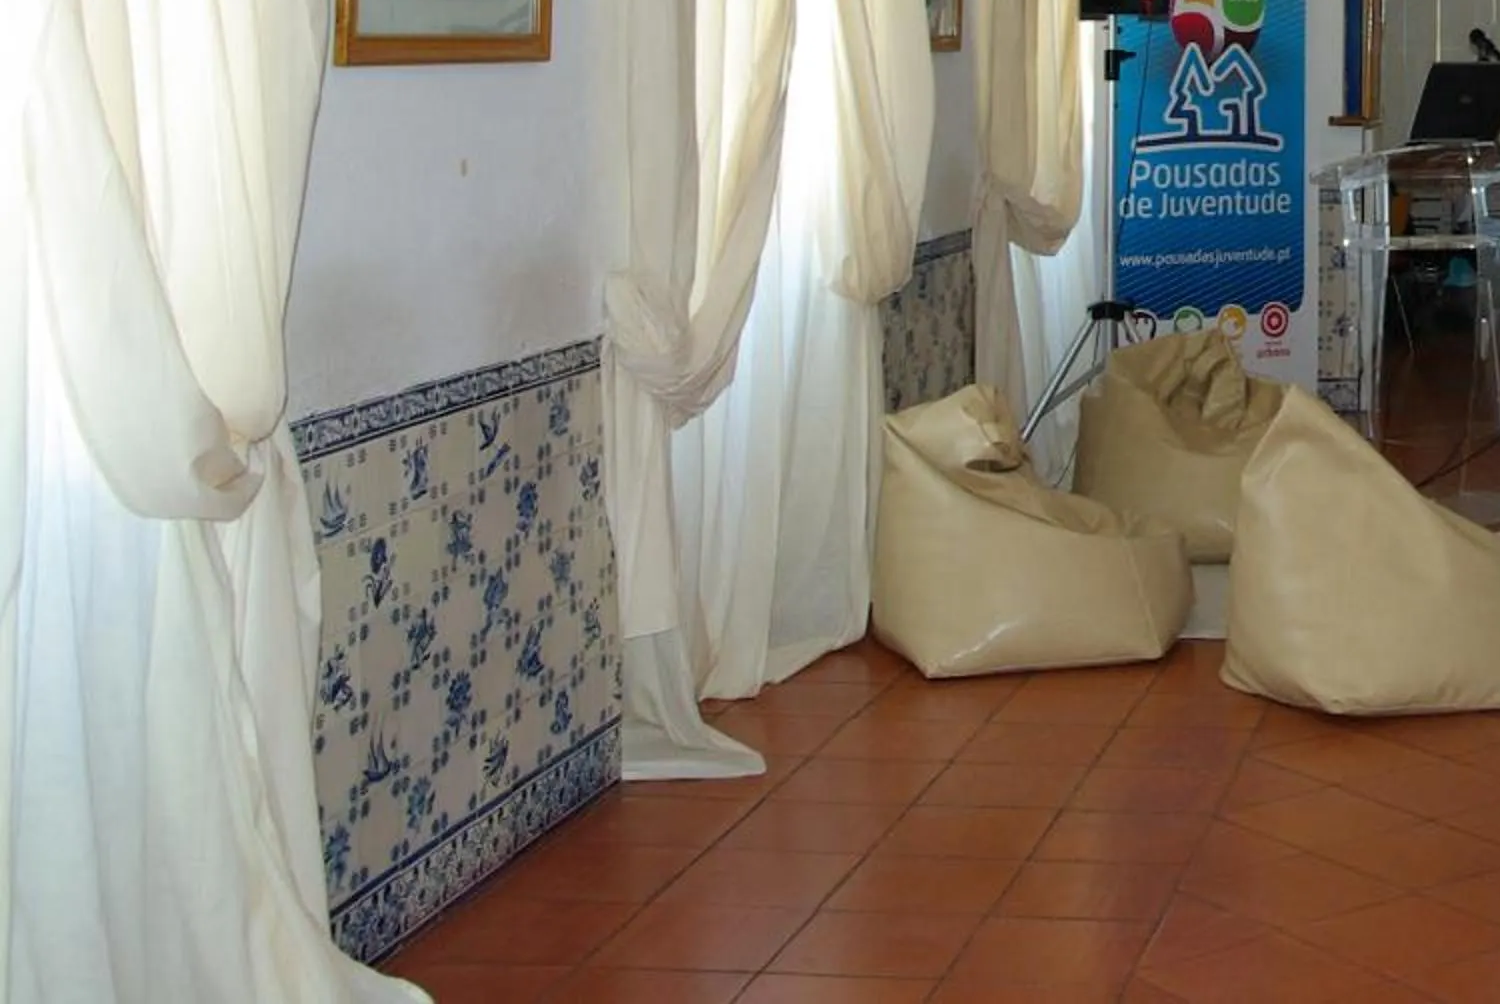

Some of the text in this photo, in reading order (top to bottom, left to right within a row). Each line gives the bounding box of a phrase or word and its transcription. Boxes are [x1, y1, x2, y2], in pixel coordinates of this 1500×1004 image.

[1131, 158, 1282, 189] Pousadas
[1119, 190, 1292, 219] de Juventude
